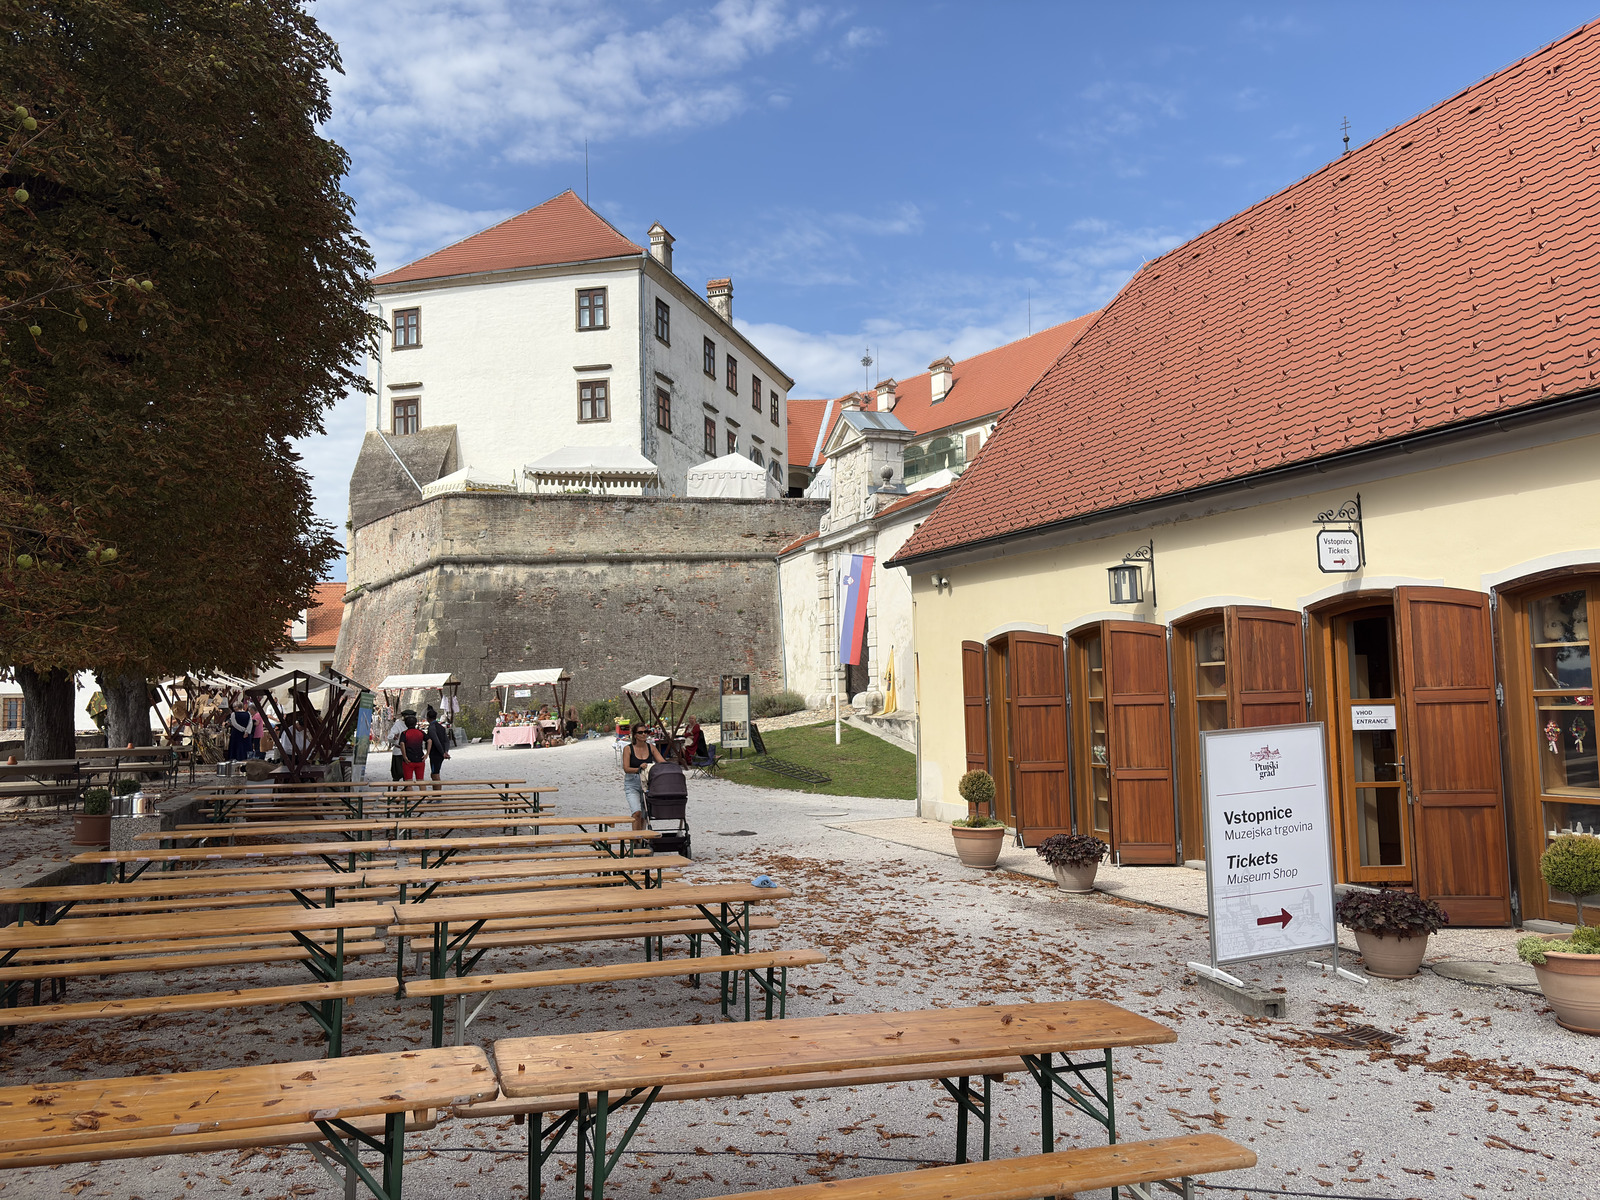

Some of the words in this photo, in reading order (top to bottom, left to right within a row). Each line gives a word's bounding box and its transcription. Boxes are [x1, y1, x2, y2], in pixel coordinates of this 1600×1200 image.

[1324, 538, 1352, 546] Vstopnice
[1255, 761, 1279, 772] Ptujski
[1259, 770, 1276, 780] grad
[1224, 806, 1293, 825] Vstopnice
[1224, 826, 1272, 840] Muzejska
[1274, 822, 1313, 836] trgovina
[1226, 851, 1278, 869] Tickets
[1227, 871, 1271, 885] Museum
[1273, 867, 1298, 880] Shop
